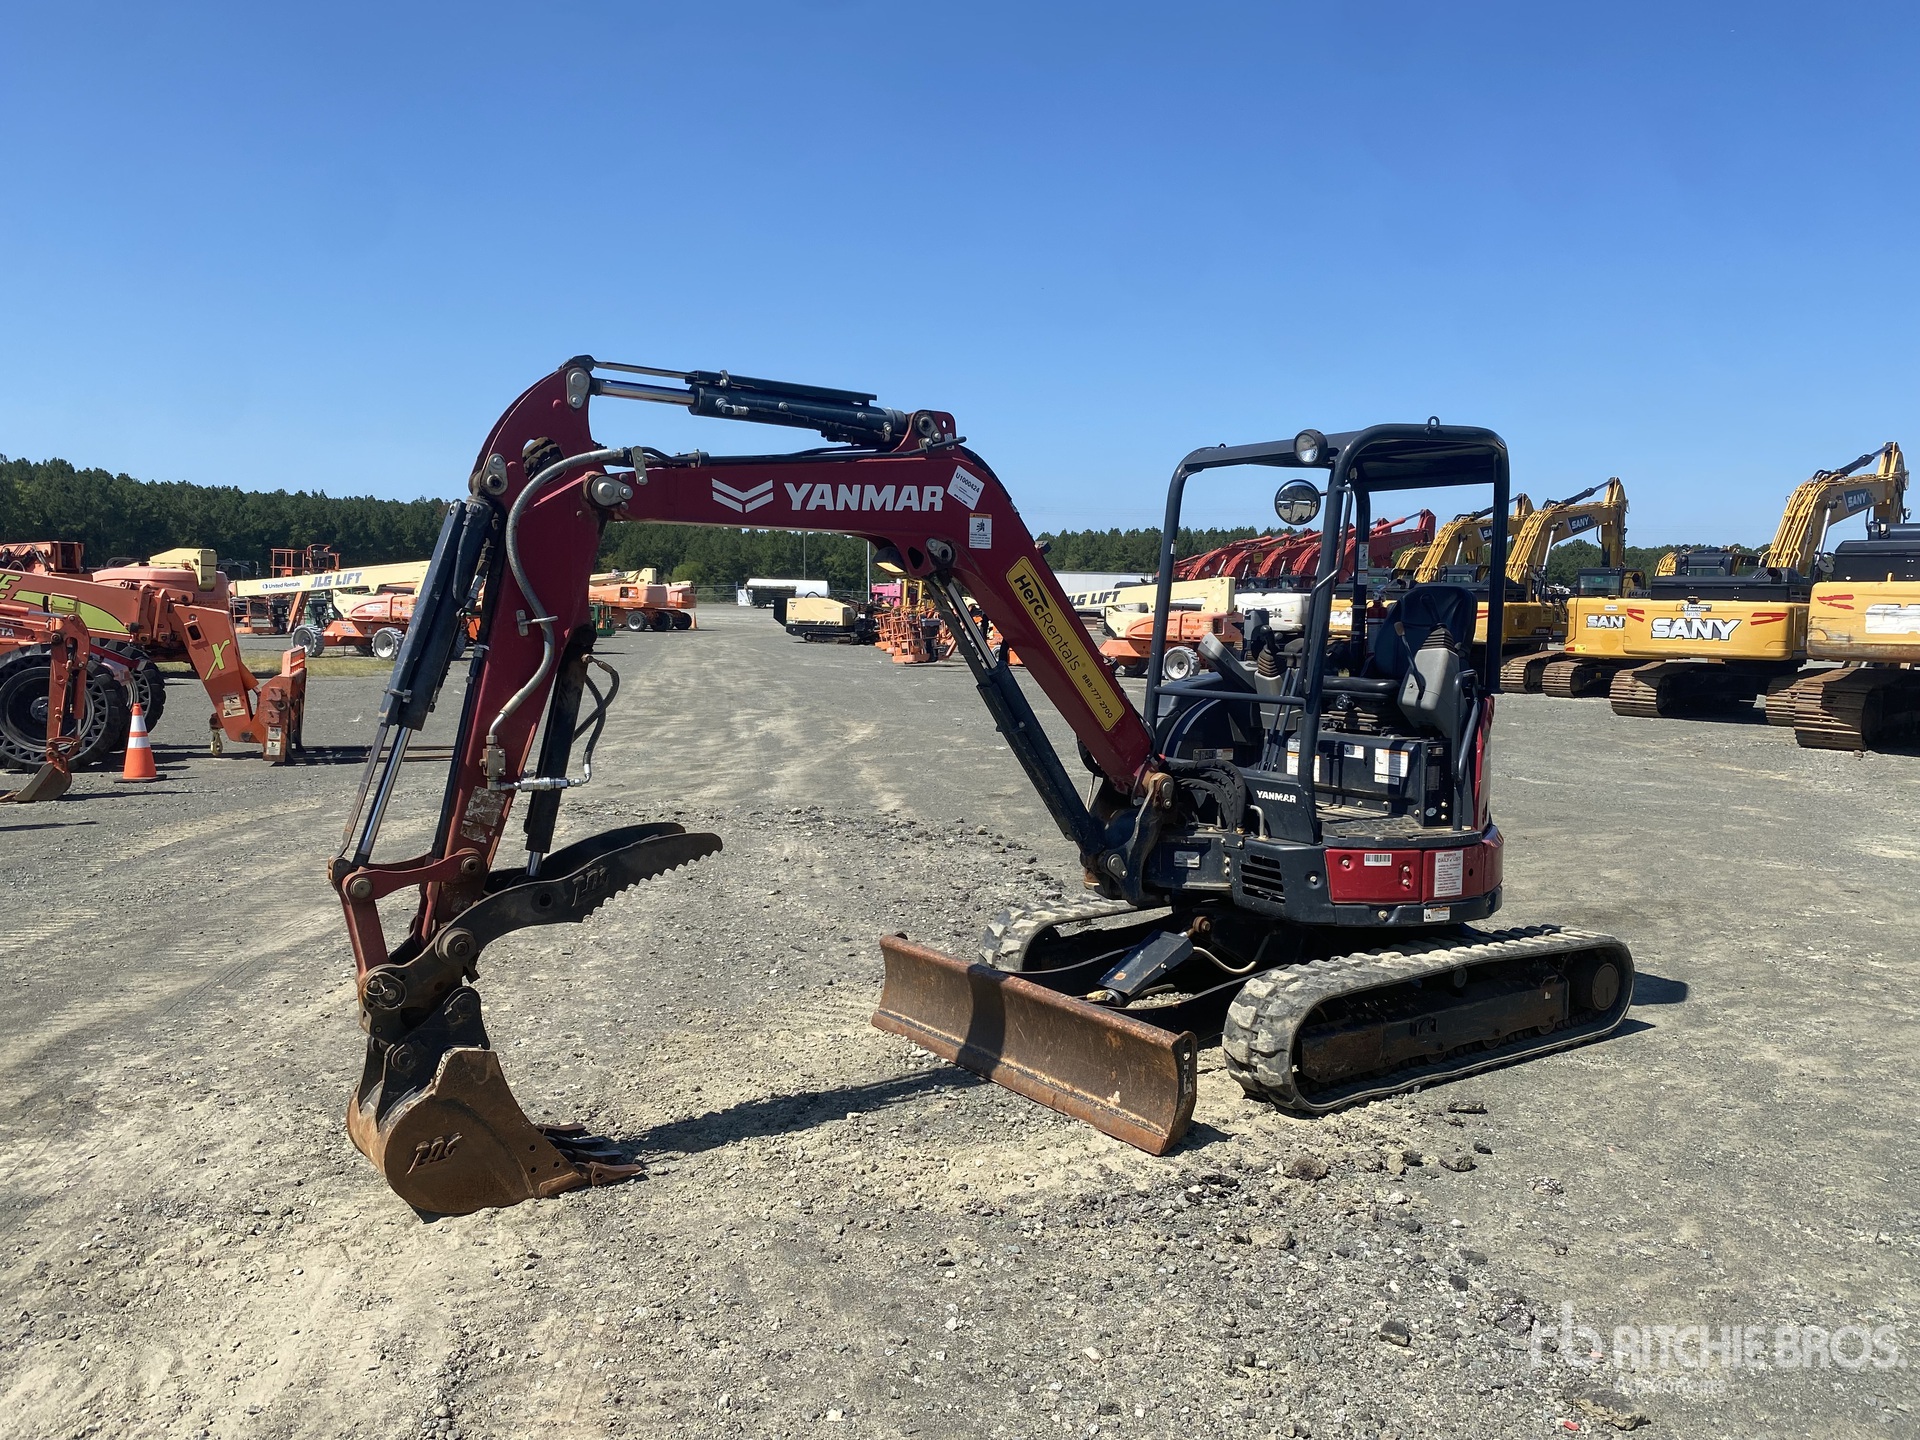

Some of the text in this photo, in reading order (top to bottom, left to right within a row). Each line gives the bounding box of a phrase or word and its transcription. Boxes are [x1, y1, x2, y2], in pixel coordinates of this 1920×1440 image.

[784, 482, 944, 512] YANMAR
[1848, 492, 1867, 508] SANY
[1571, 516, 1589, 530] SANY
[311, 572, 363, 588] JLG LIFT
[1090, 590, 1121, 605] LIFT
[1586, 614, 1626, 628] SAN
[1651, 617, 1742, 641] SANY
[1082, 673, 1114, 719] 888-777-2700
[1256, 789, 1297, 804] YANMAR
